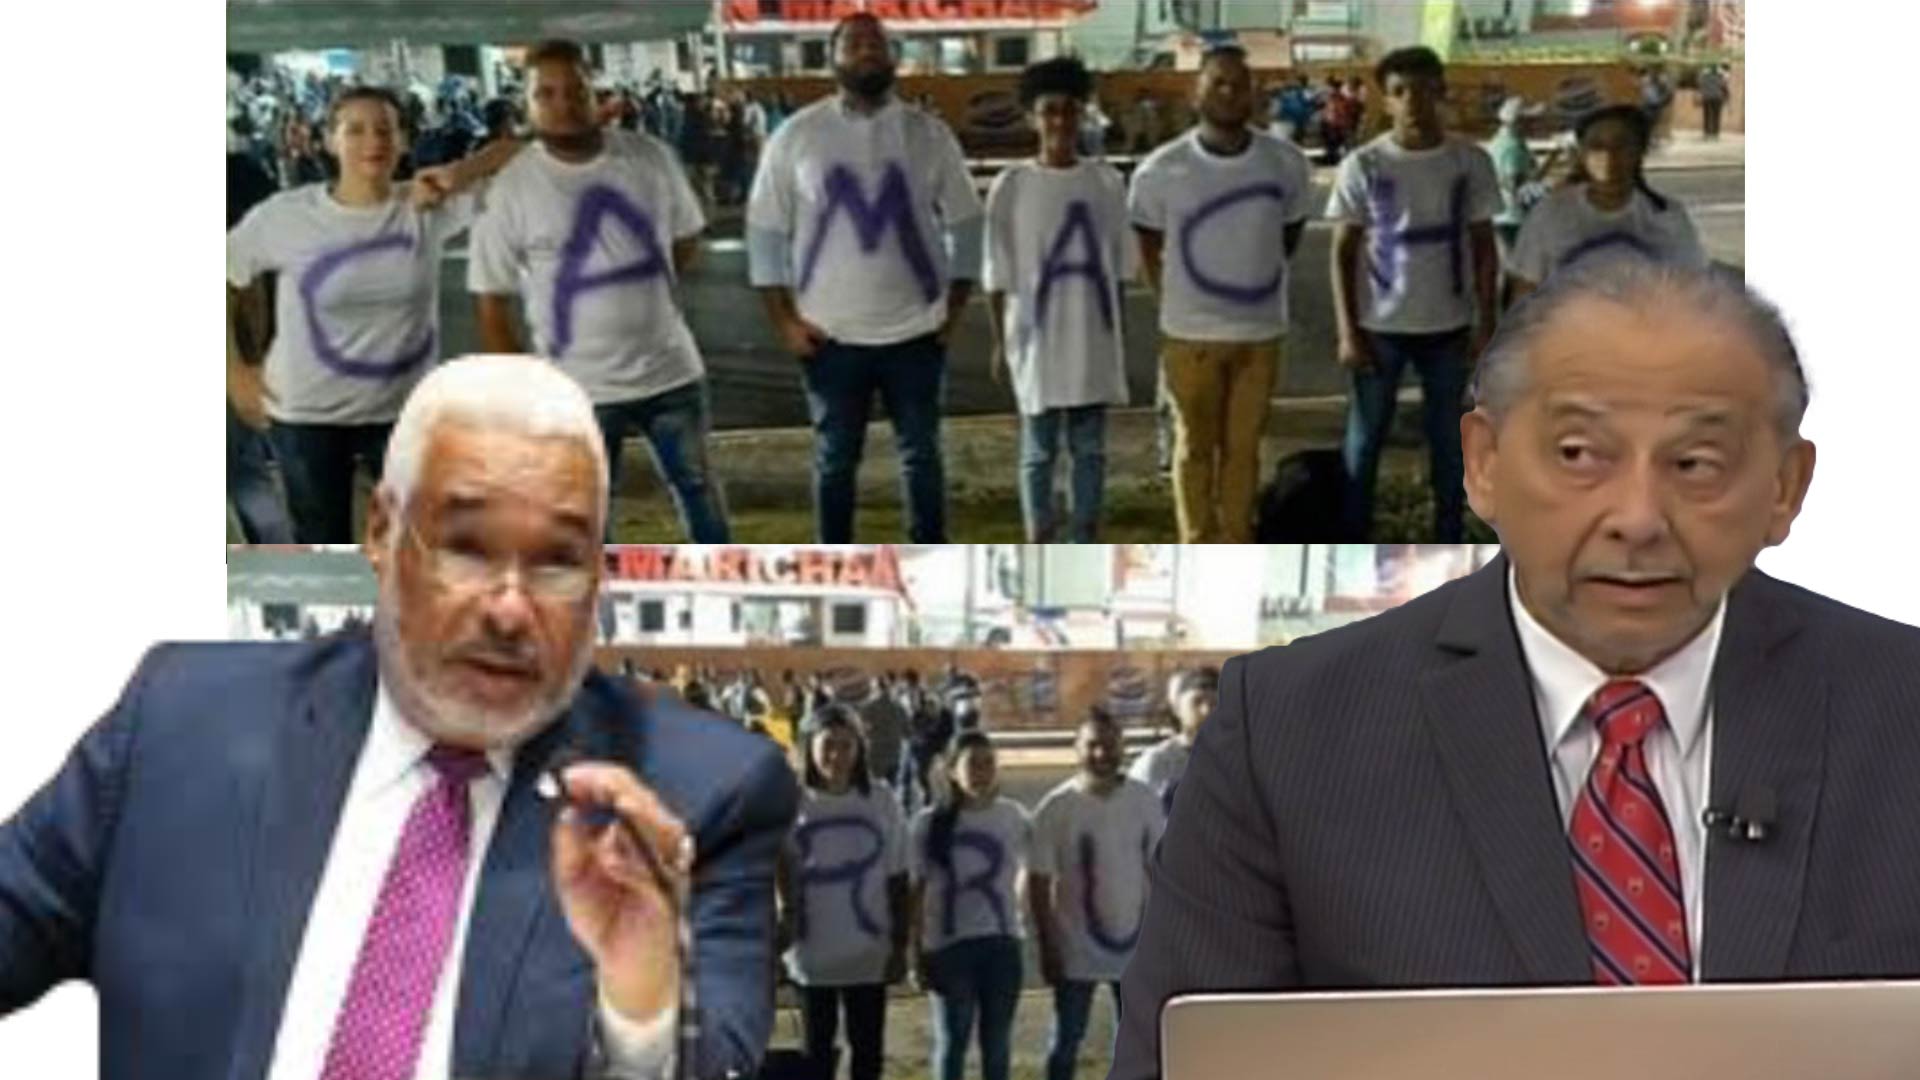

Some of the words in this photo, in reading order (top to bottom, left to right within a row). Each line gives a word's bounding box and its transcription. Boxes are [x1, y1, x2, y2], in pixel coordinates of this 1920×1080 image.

[551, 184, 664, 358] A
[799, 160, 942, 305] M
[1035, 199, 1114, 329] A
[1181, 181, 1287, 303] C
[1368, 172, 1468, 294] H
[300, 232, 440, 378] C
[796, 816, 885, 939] R
[936, 830, 1010, 936] R
[1079, 824, 1150, 954] U
